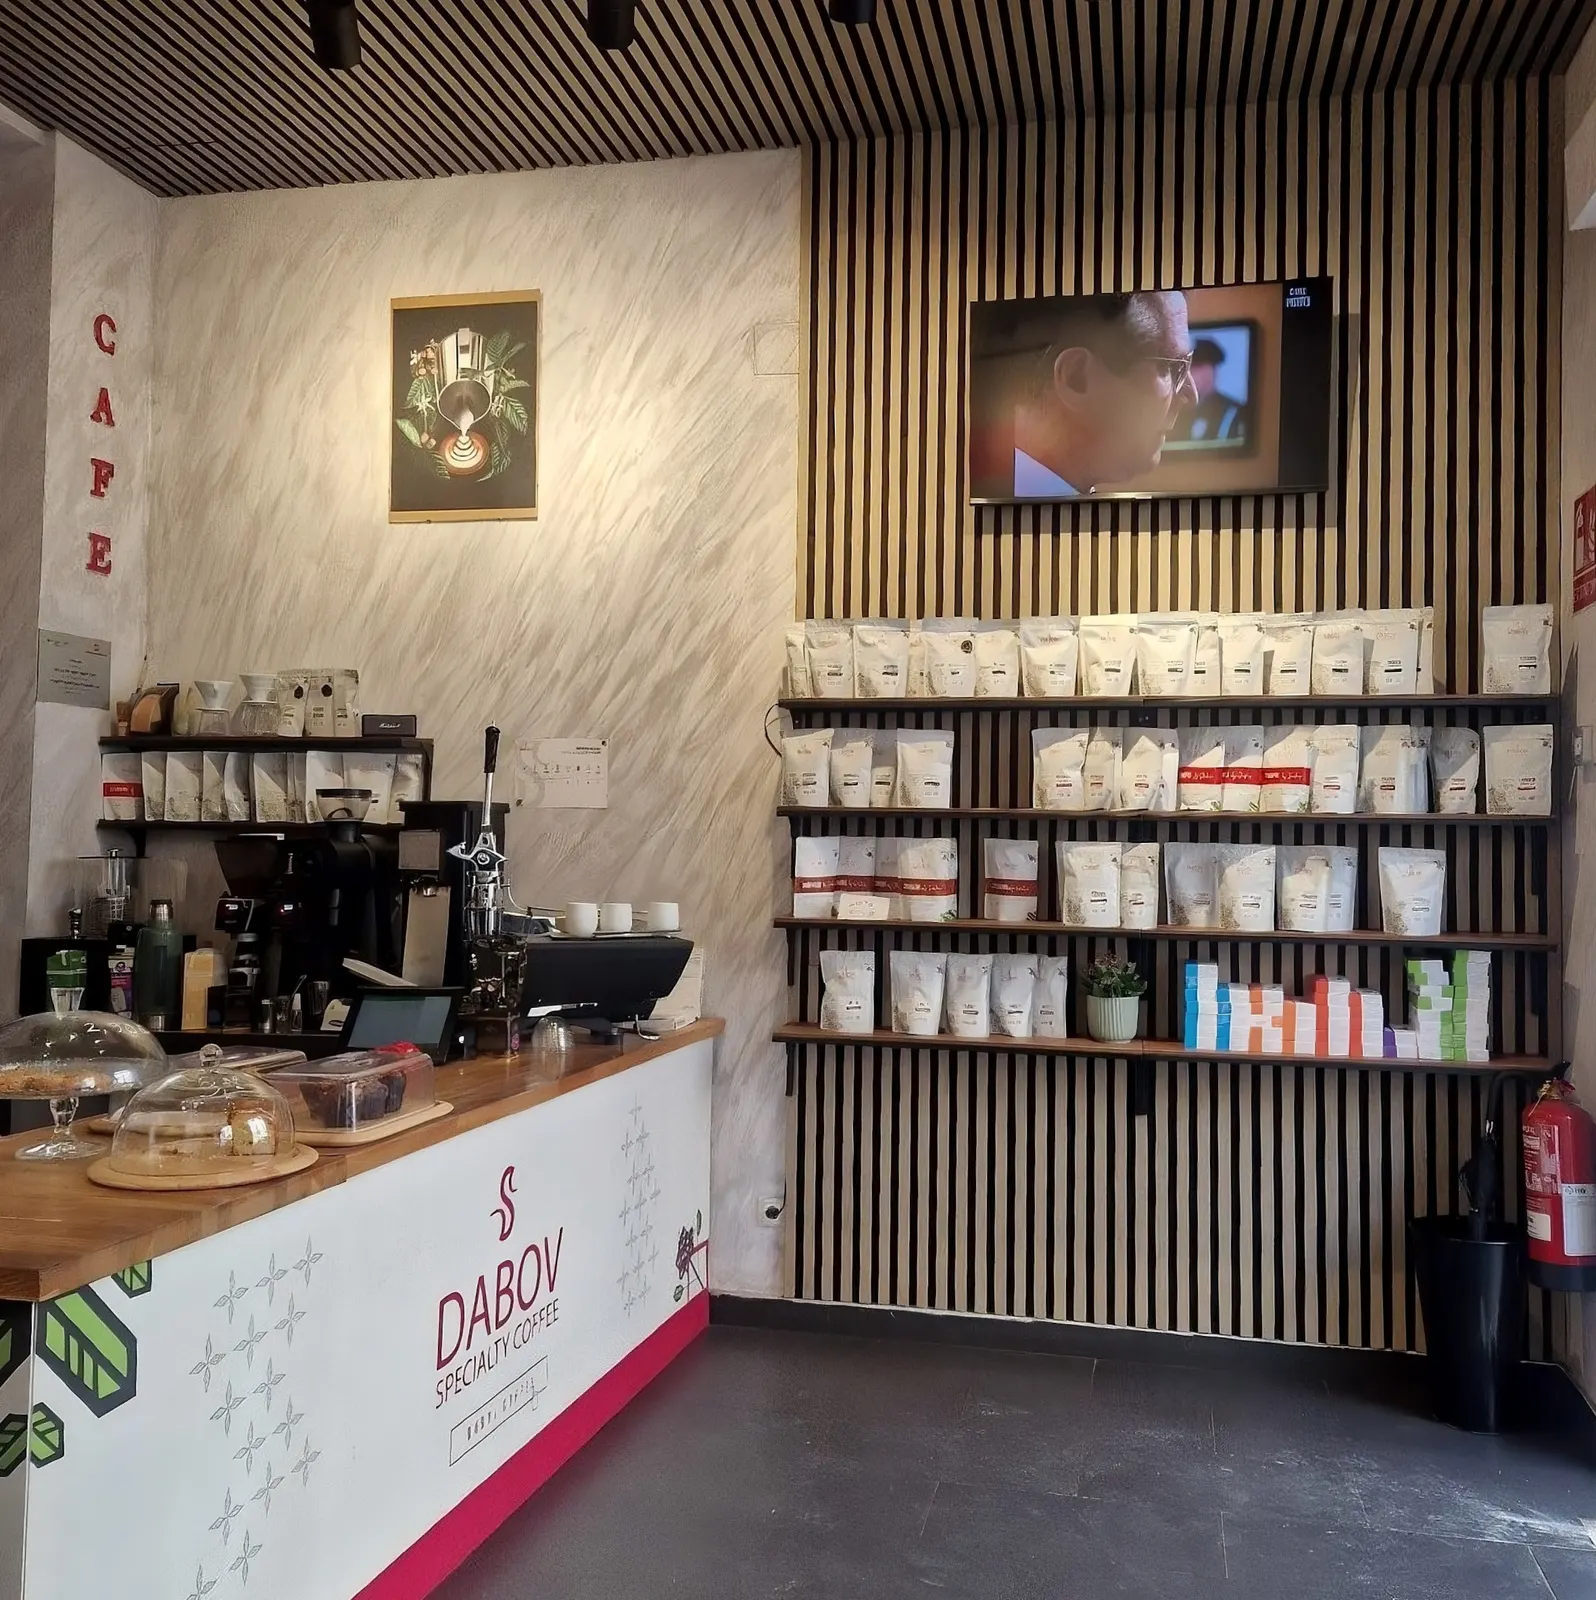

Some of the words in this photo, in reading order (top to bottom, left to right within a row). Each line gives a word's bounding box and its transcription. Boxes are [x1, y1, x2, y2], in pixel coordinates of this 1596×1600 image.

[86, 313, 117, 577] CAFE
[435, 1226, 564, 1371] DABOV
[435, 1331, 511, 1409] SPECIALTY
[513, 1298, 560, 1350] COFFEE
